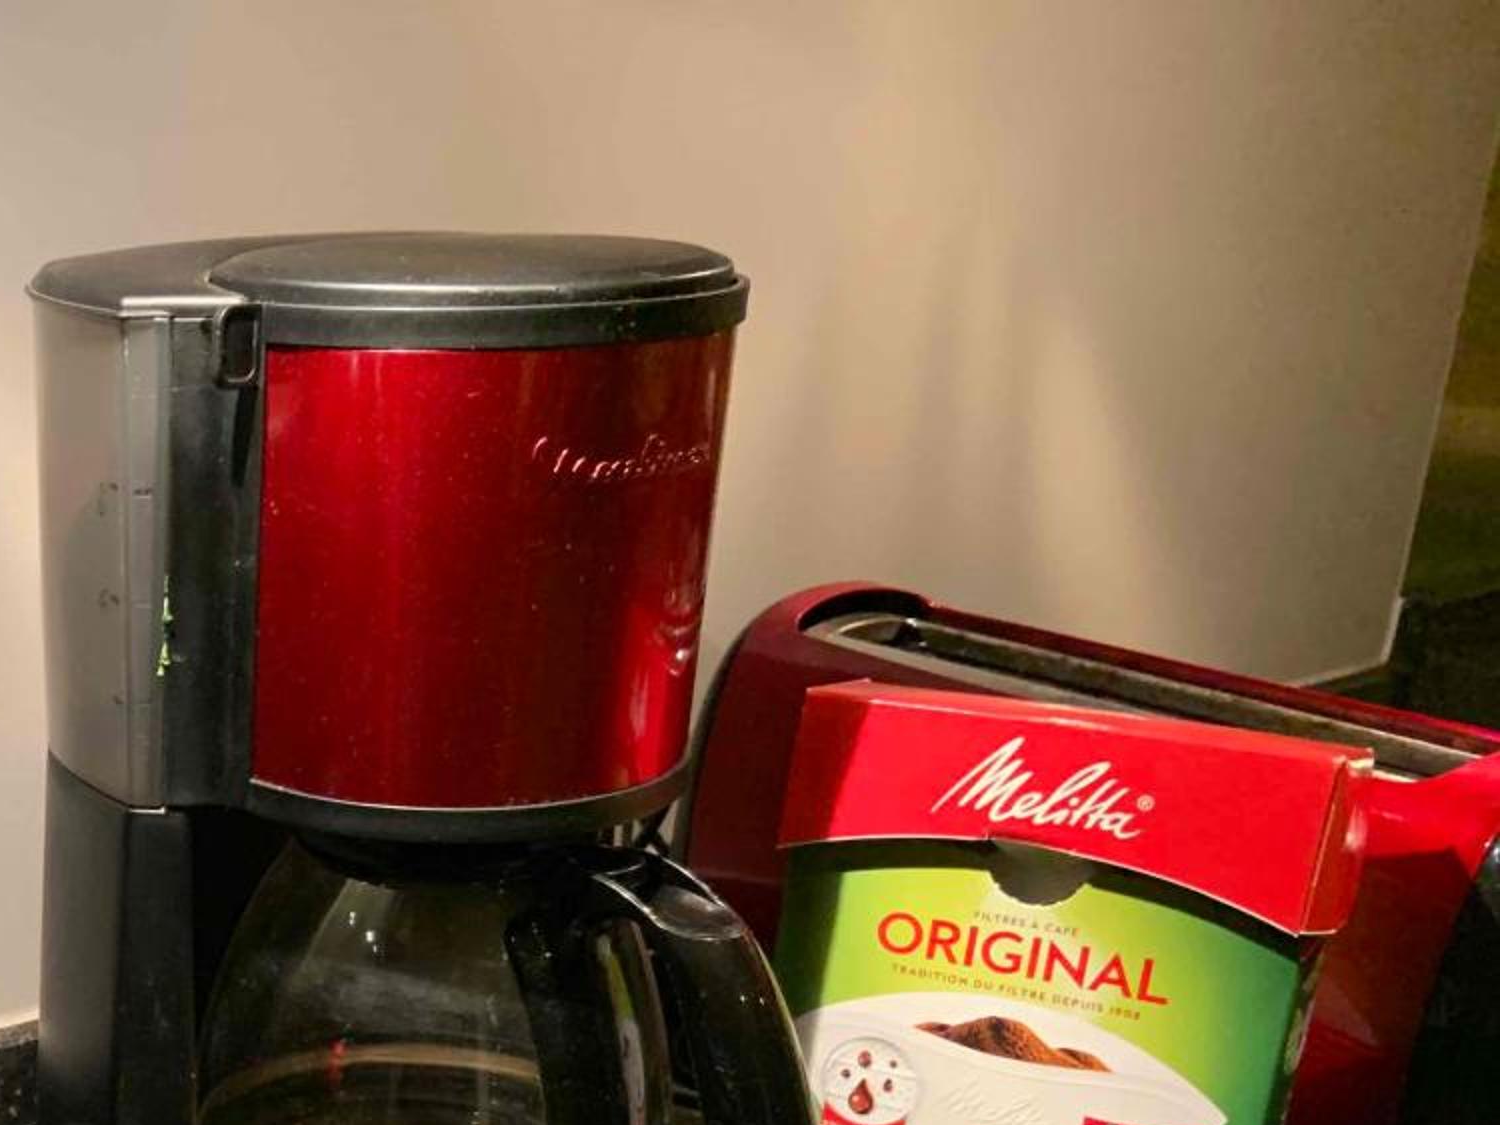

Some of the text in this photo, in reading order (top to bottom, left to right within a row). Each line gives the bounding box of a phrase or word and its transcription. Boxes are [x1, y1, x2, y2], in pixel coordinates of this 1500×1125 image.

[876, 910, 1171, 1007] ORIGINAL
[891, 962, 969, 987] TRADITION
[973, 978, 993, 991] DU
[998, 983, 1045, 1002] FILTRE
[1051, 993, 1104, 1014] DEPUIS
